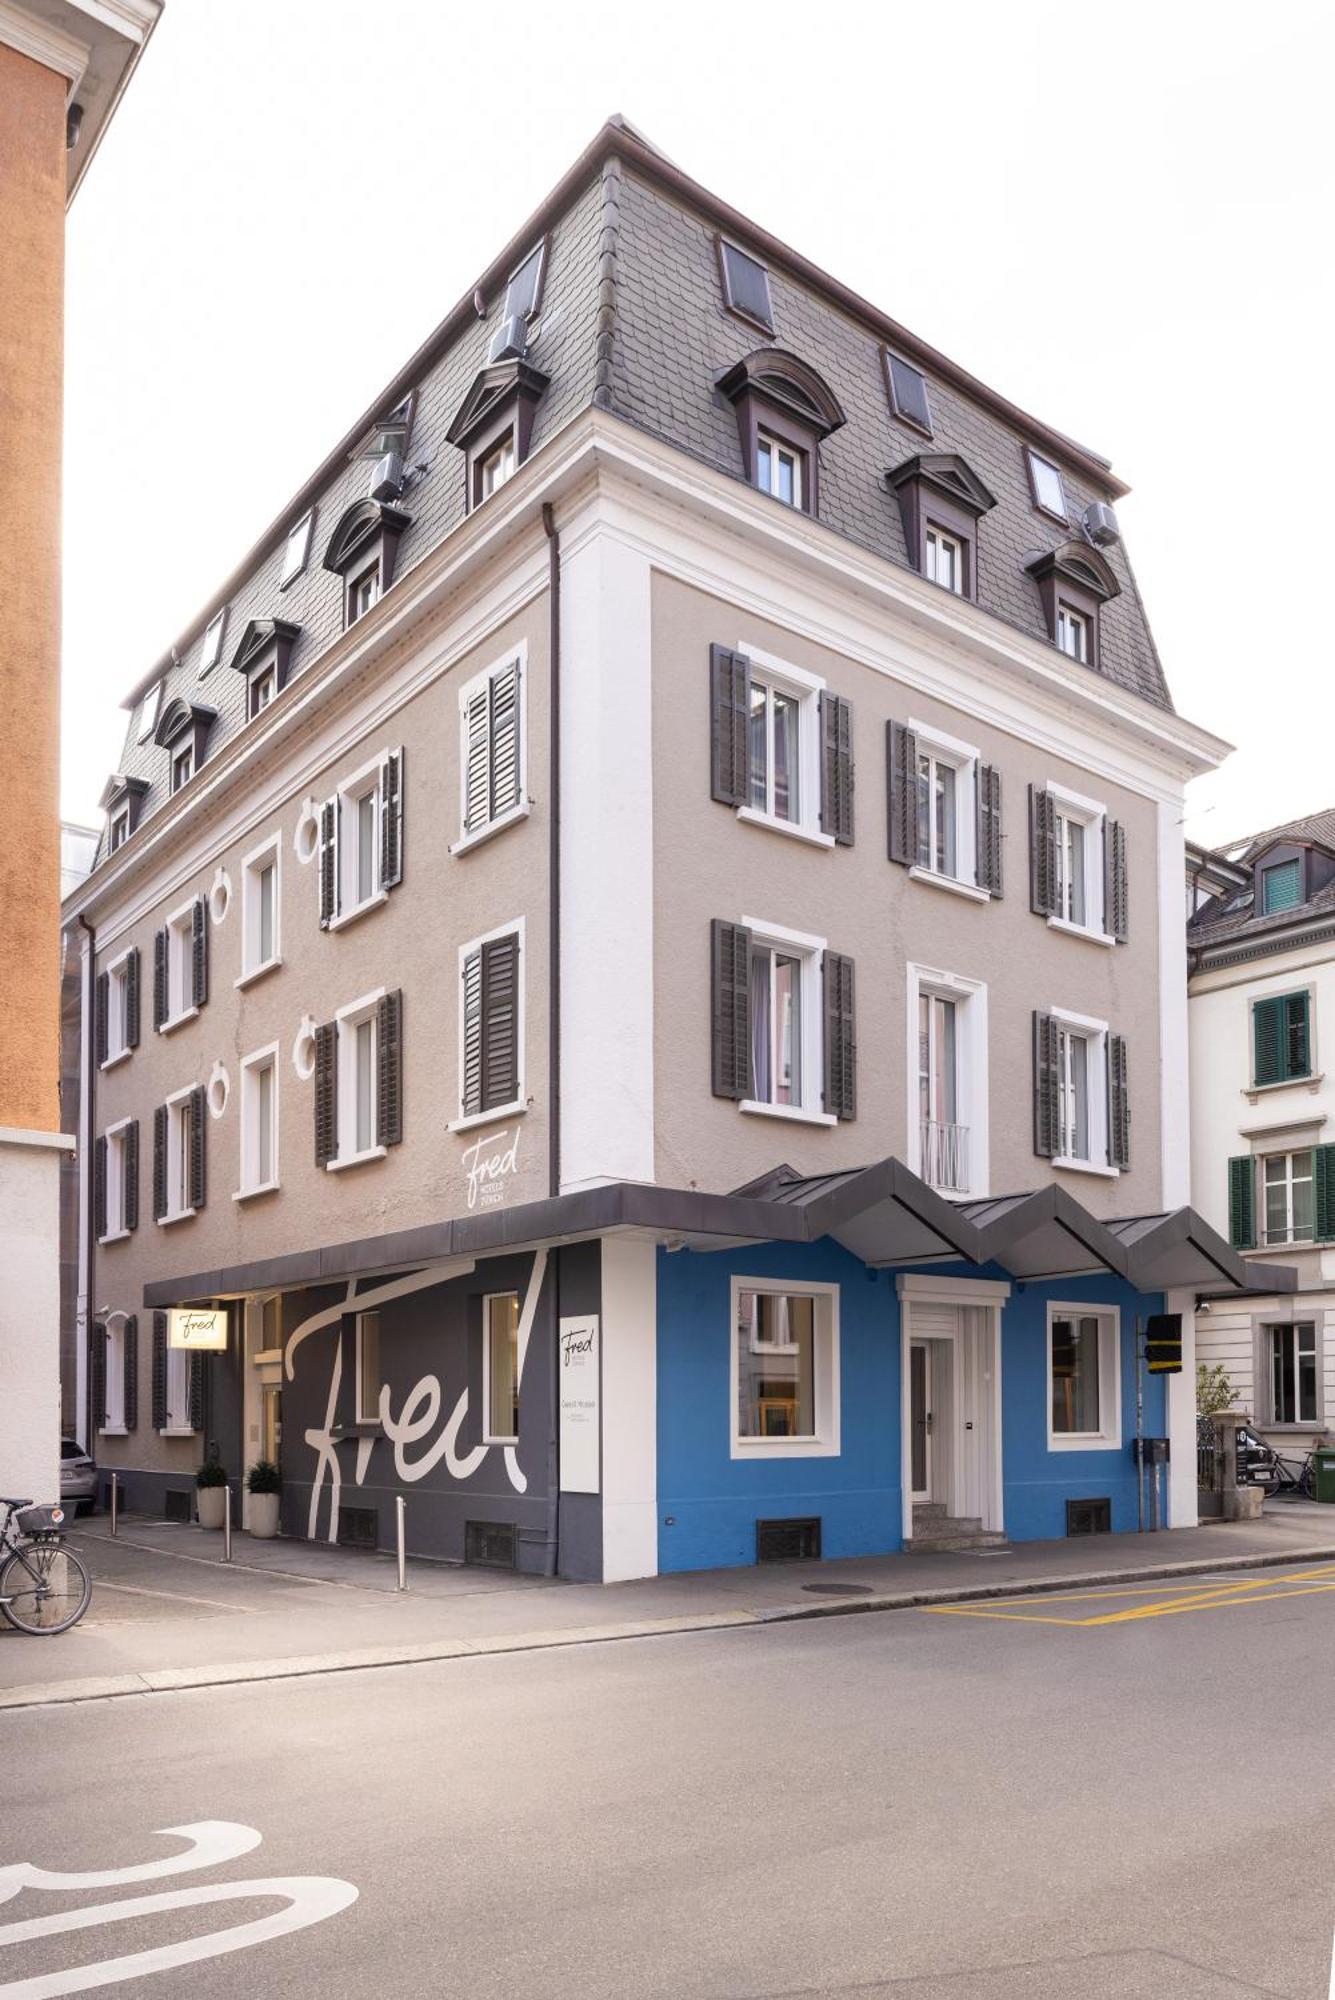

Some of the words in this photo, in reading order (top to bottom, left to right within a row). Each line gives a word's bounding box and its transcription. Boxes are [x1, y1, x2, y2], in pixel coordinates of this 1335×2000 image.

[462, 1126, 520, 1209] Fred
[180, 1313, 217, 1339] Fred
[561, 1328, 594, 1367] Fred
[285, 1248, 549, 1543] Fred
